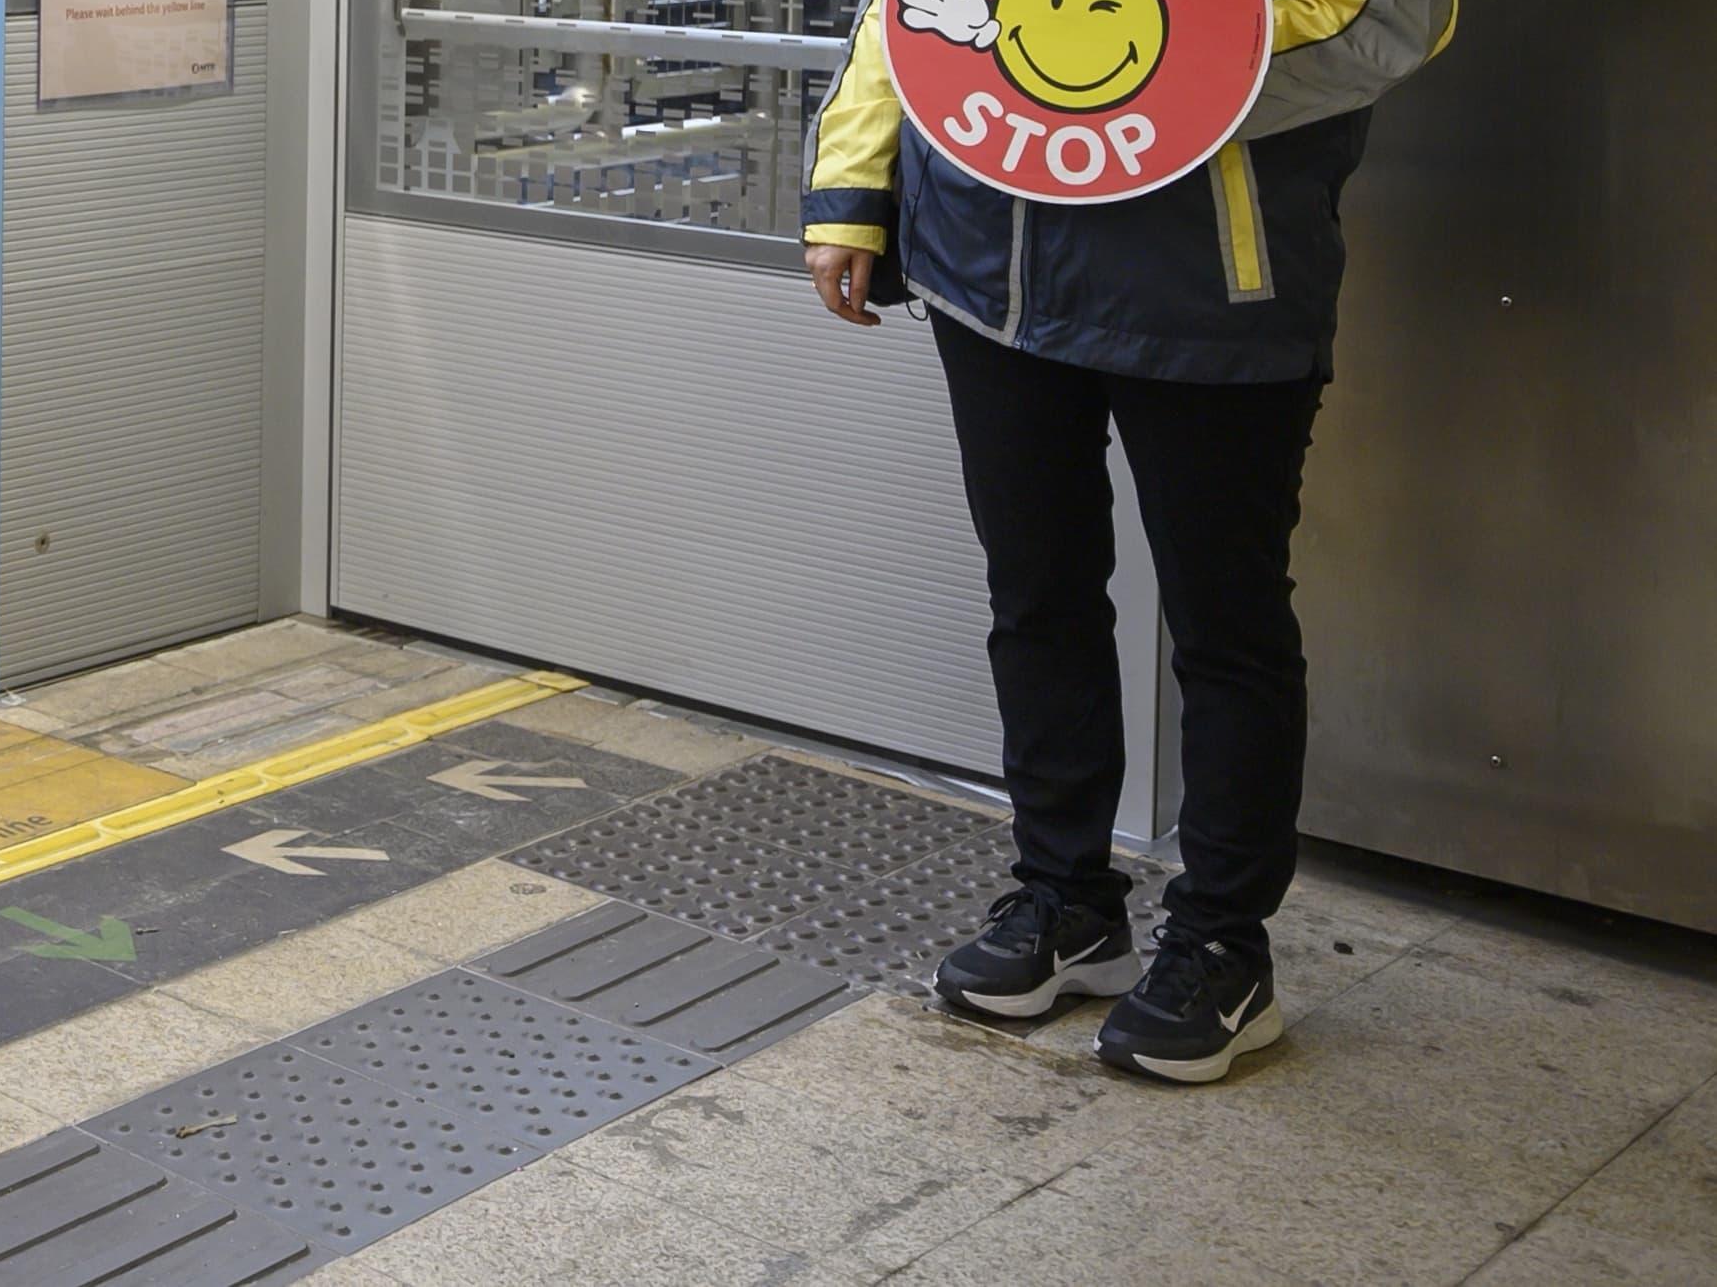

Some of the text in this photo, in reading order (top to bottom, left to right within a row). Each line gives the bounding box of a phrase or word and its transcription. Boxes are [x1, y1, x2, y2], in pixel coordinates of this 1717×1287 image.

[66, 7, 93, 21] Please
[95, 6, 114, 19] wait
[115, 2, 145, 17] behind
[146, 1, 160, 14] the
[162, 1, 188, 16] yellow
[943, 91, 1156, 185] STOP
